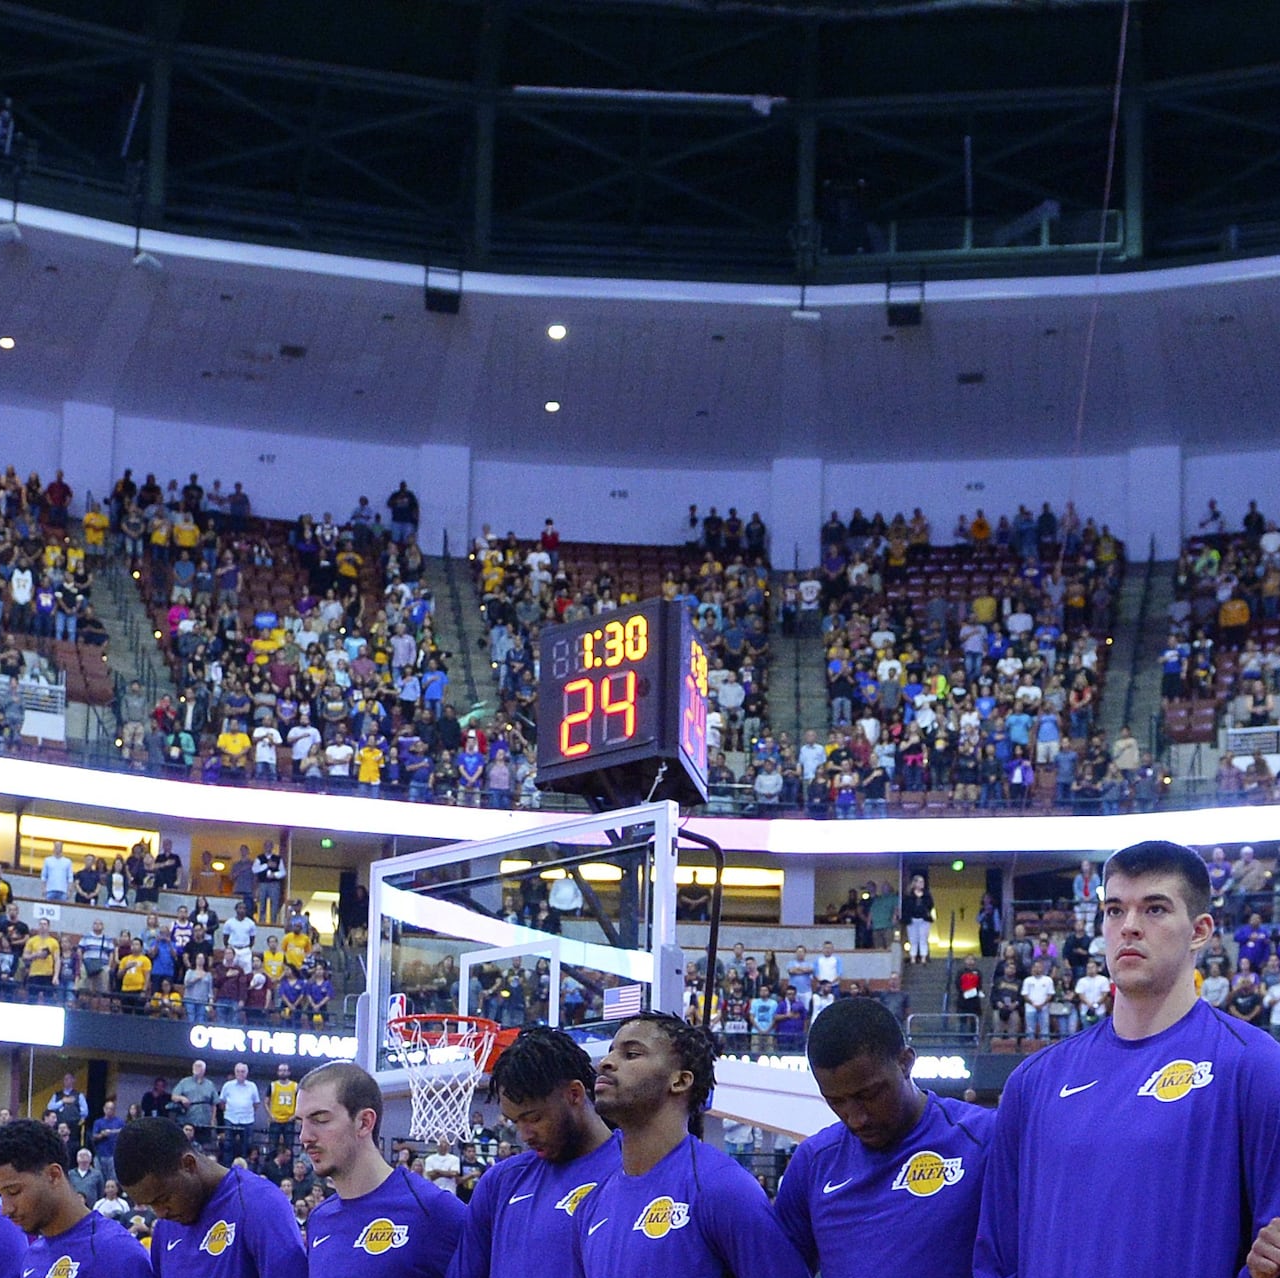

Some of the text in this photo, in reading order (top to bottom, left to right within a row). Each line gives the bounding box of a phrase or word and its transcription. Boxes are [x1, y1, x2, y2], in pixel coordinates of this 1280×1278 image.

[583, 614, 649, 670] 1:30
[560, 669, 638, 757] 24
[39, 907, 56, 917] 310
[190, 1025, 246, 1052] O'ER
[247, 1029, 297, 1056] THE
[1149, 1069, 1205, 1092] LAKERS
[899, 1165, 957, 1187] LAKERS
[639, 1208, 684, 1228] LAKERS
[359, 1228, 404, 1246] LAKERS
